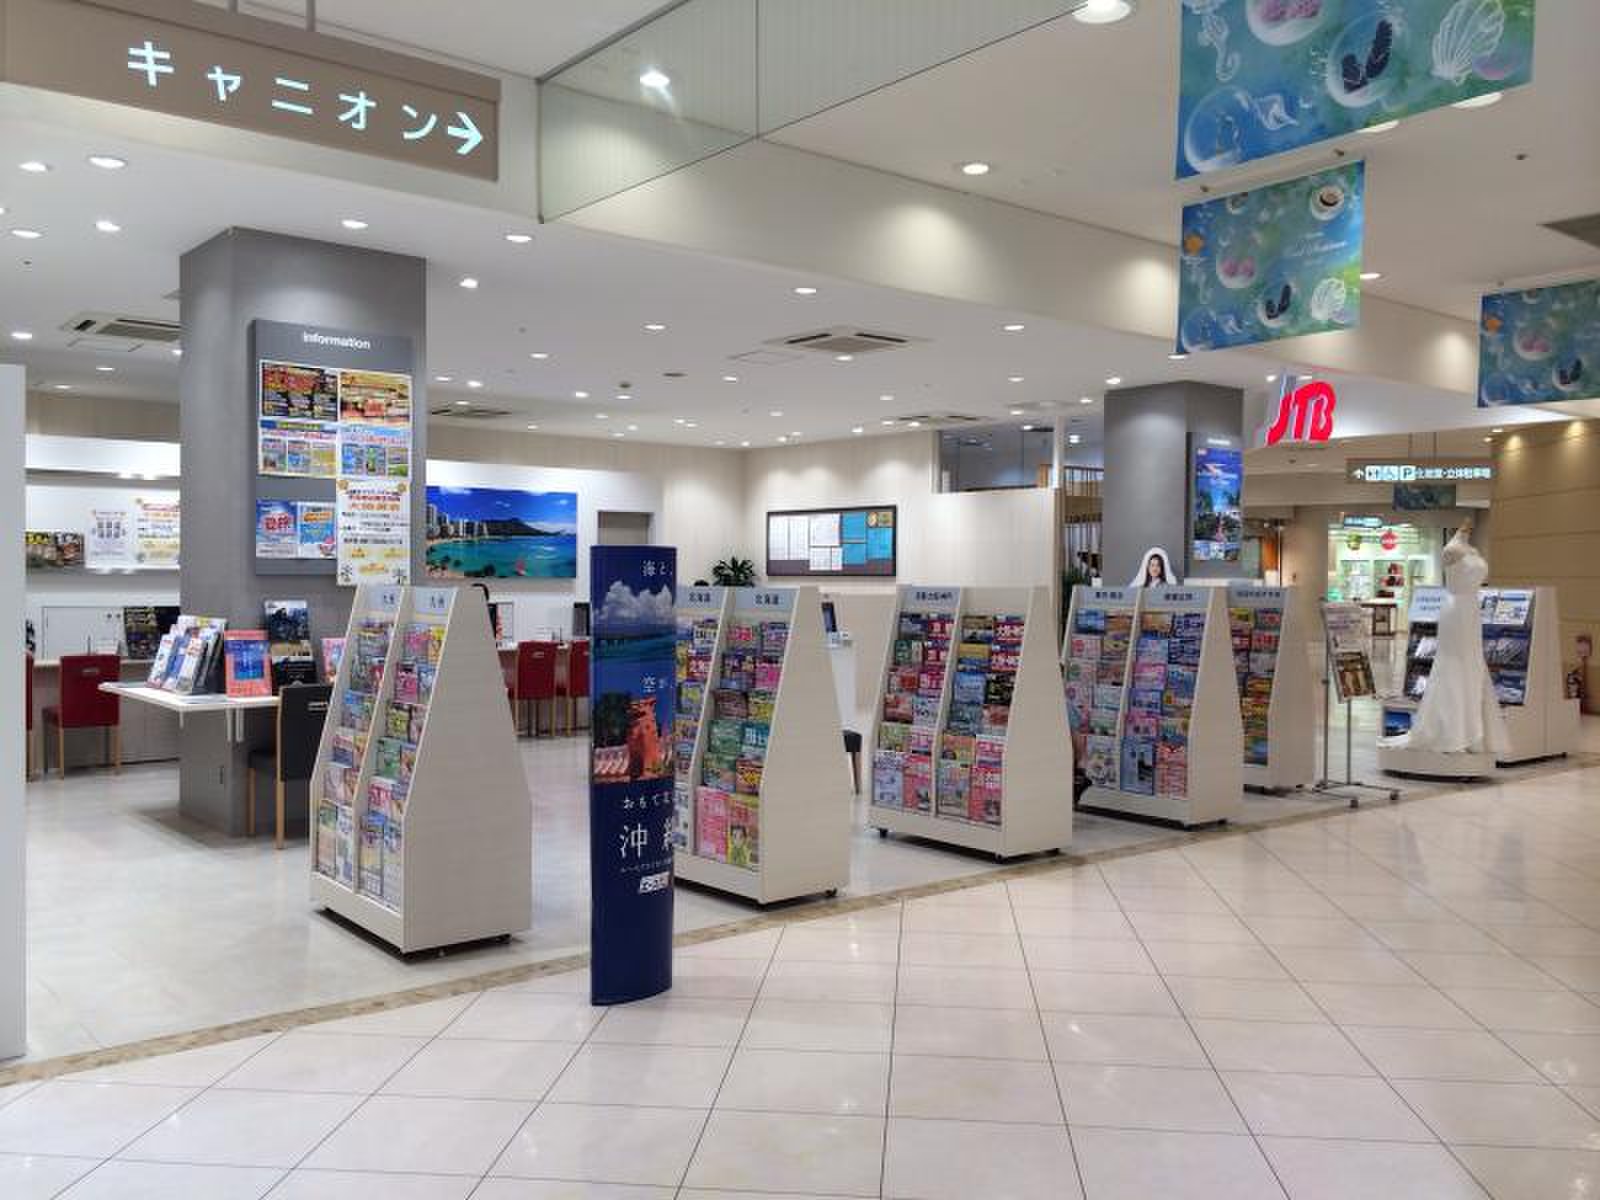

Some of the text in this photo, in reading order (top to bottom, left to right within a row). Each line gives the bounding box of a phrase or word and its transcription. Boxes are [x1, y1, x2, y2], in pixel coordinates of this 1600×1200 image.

[127, 40, 438, 142] キャニオン
[1264, 377, 1337, 446] JTB
